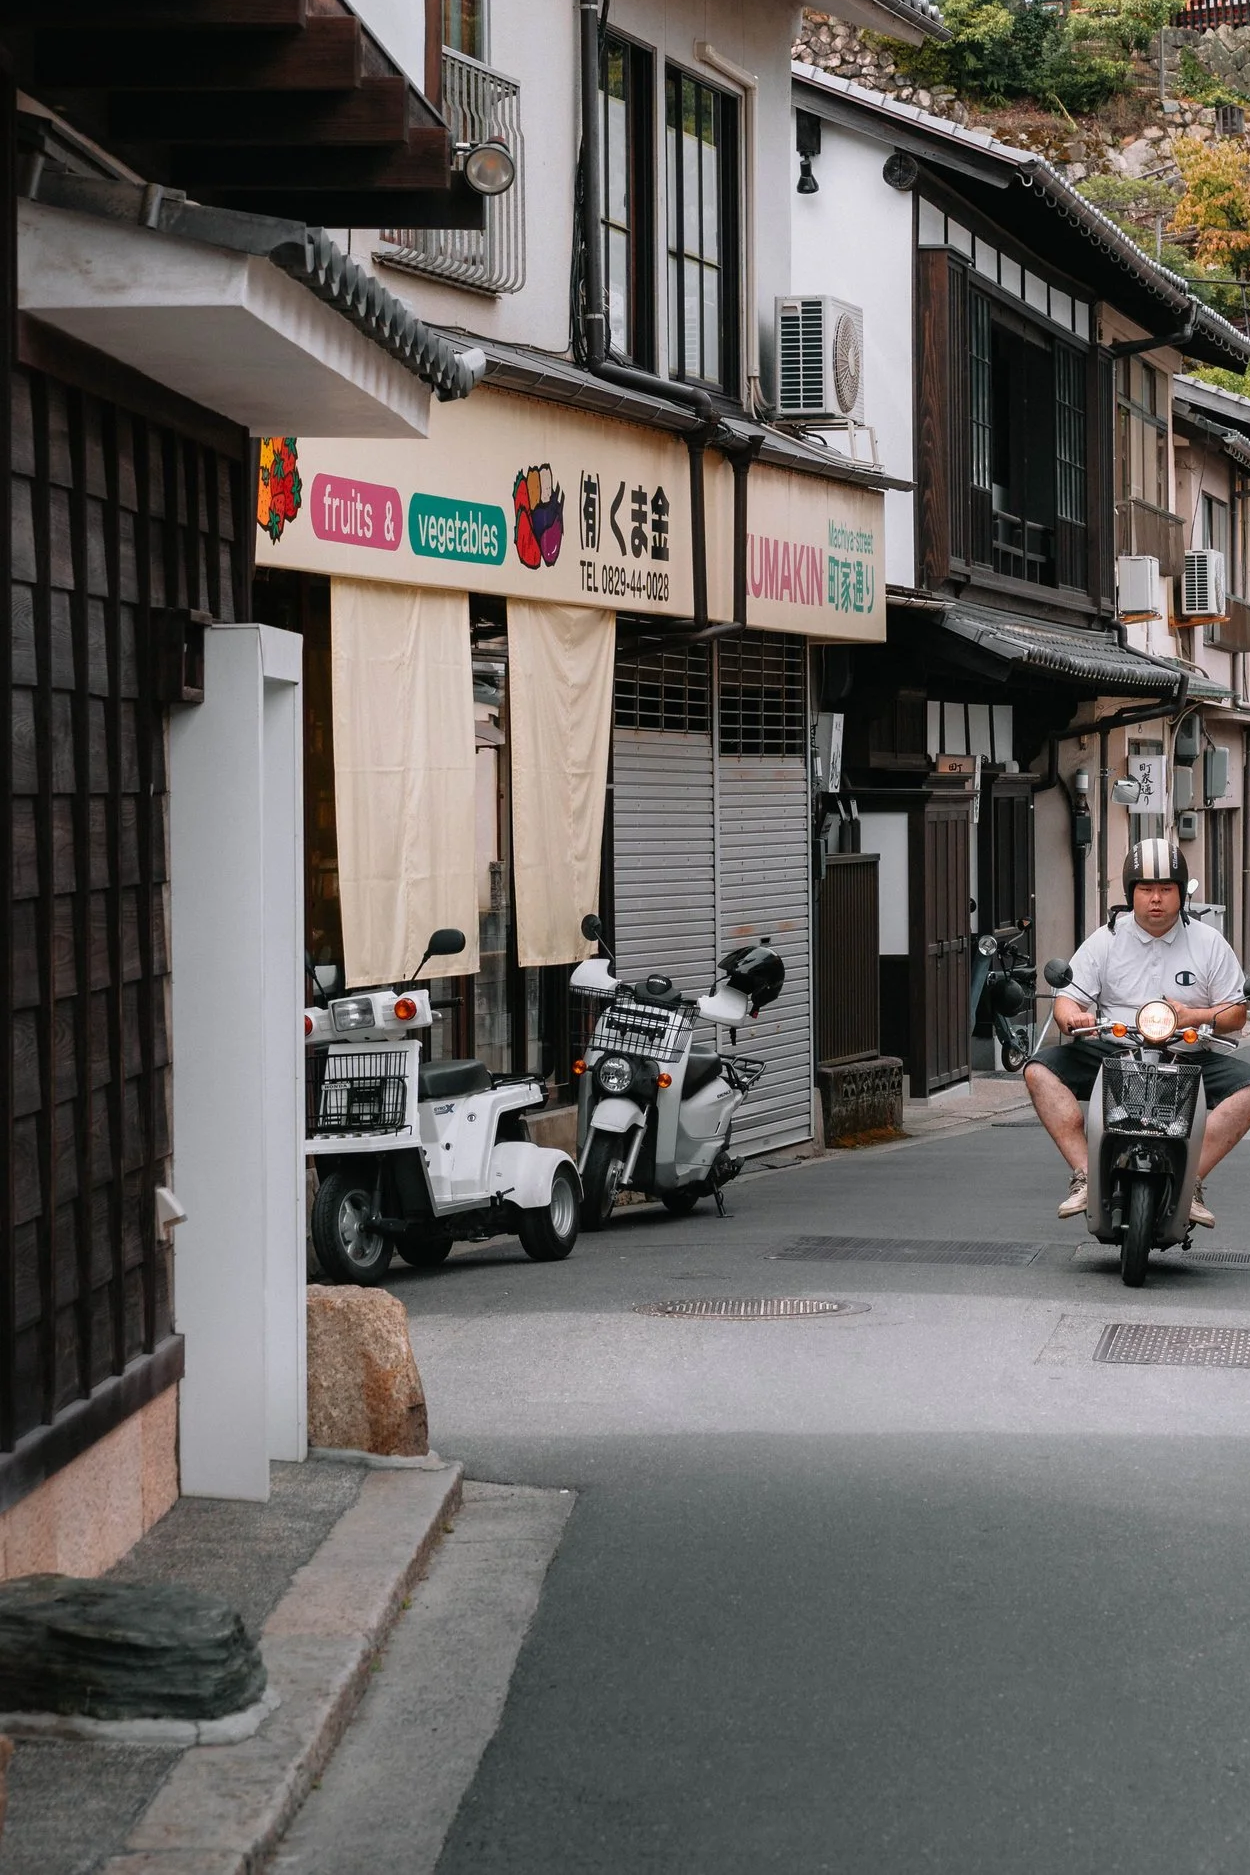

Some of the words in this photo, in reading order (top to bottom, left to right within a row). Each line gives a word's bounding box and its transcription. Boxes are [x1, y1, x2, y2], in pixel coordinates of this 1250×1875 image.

[323, 484, 373, 539] fruits
[384, 500, 395, 542] &
[418, 510, 498, 557] vegetables
[828, 518, 874, 555] Machiya-street
[579, 560, 599, 593] TEL
[602, 564, 670, 602] 0829-44-0028
[828, 555, 875, 614] 町家通り
[1139, 762, 1155, 806] 町家通り
